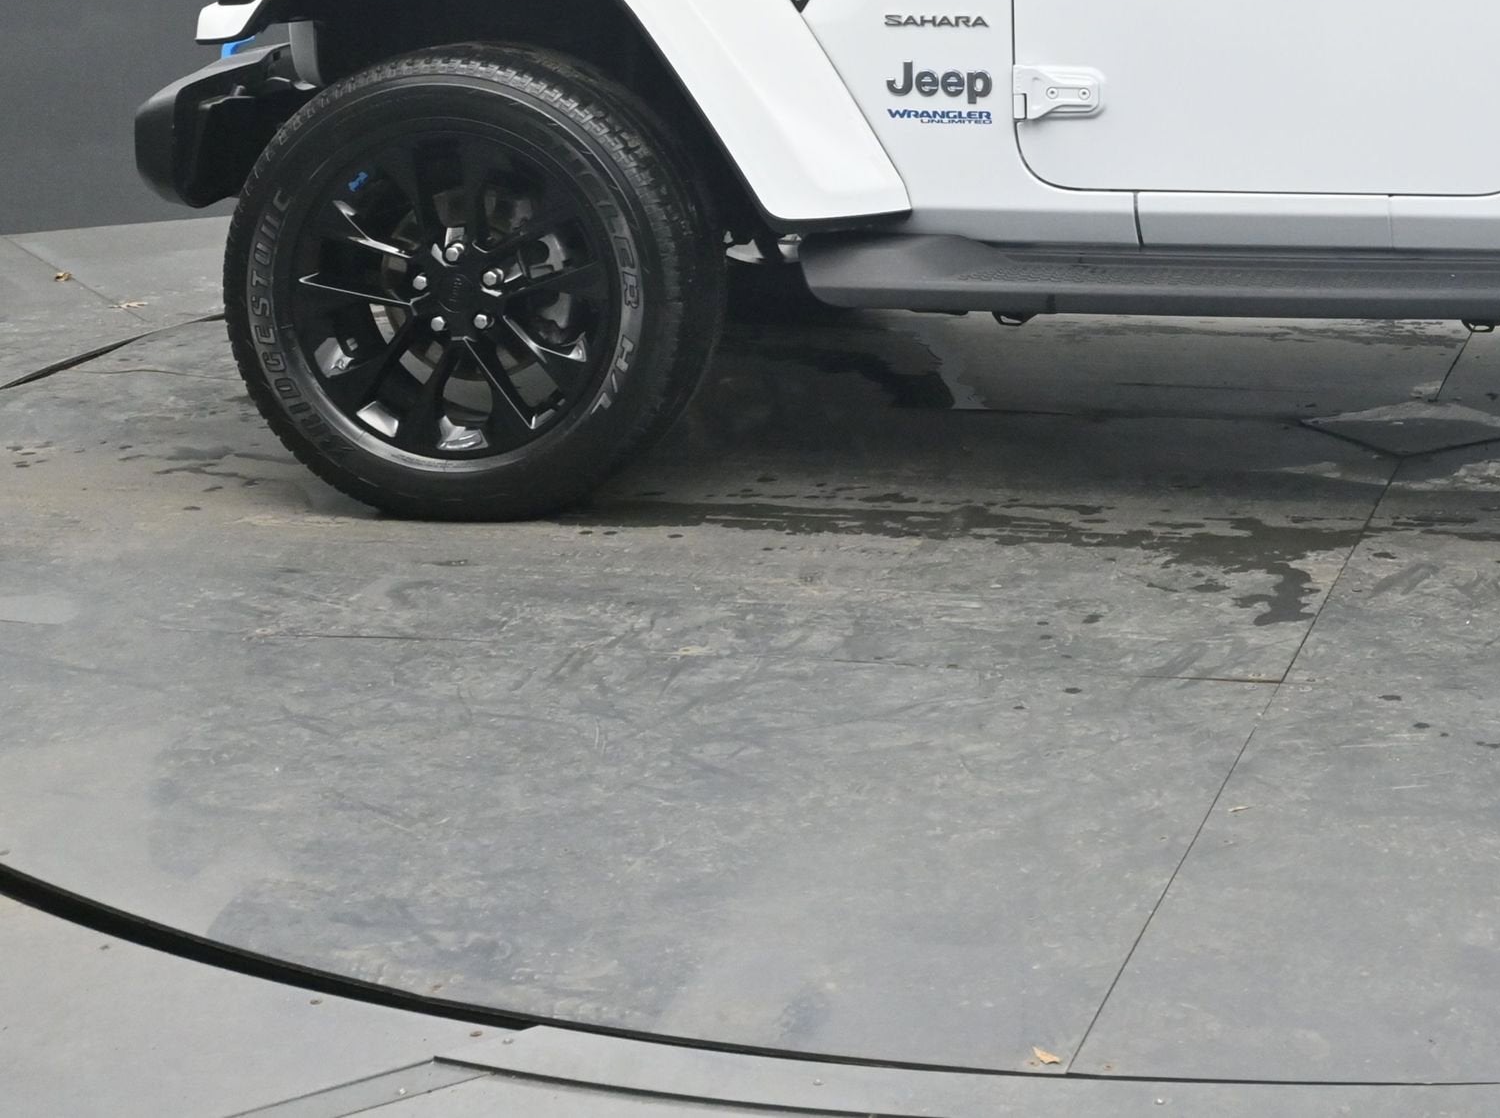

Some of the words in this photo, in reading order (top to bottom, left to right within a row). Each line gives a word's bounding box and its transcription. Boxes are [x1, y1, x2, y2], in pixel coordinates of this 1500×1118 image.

[884, 14, 989, 28] SAHARA
[886, 60, 992, 104] Jeep
[887, 108, 992, 120] WRANGLER
